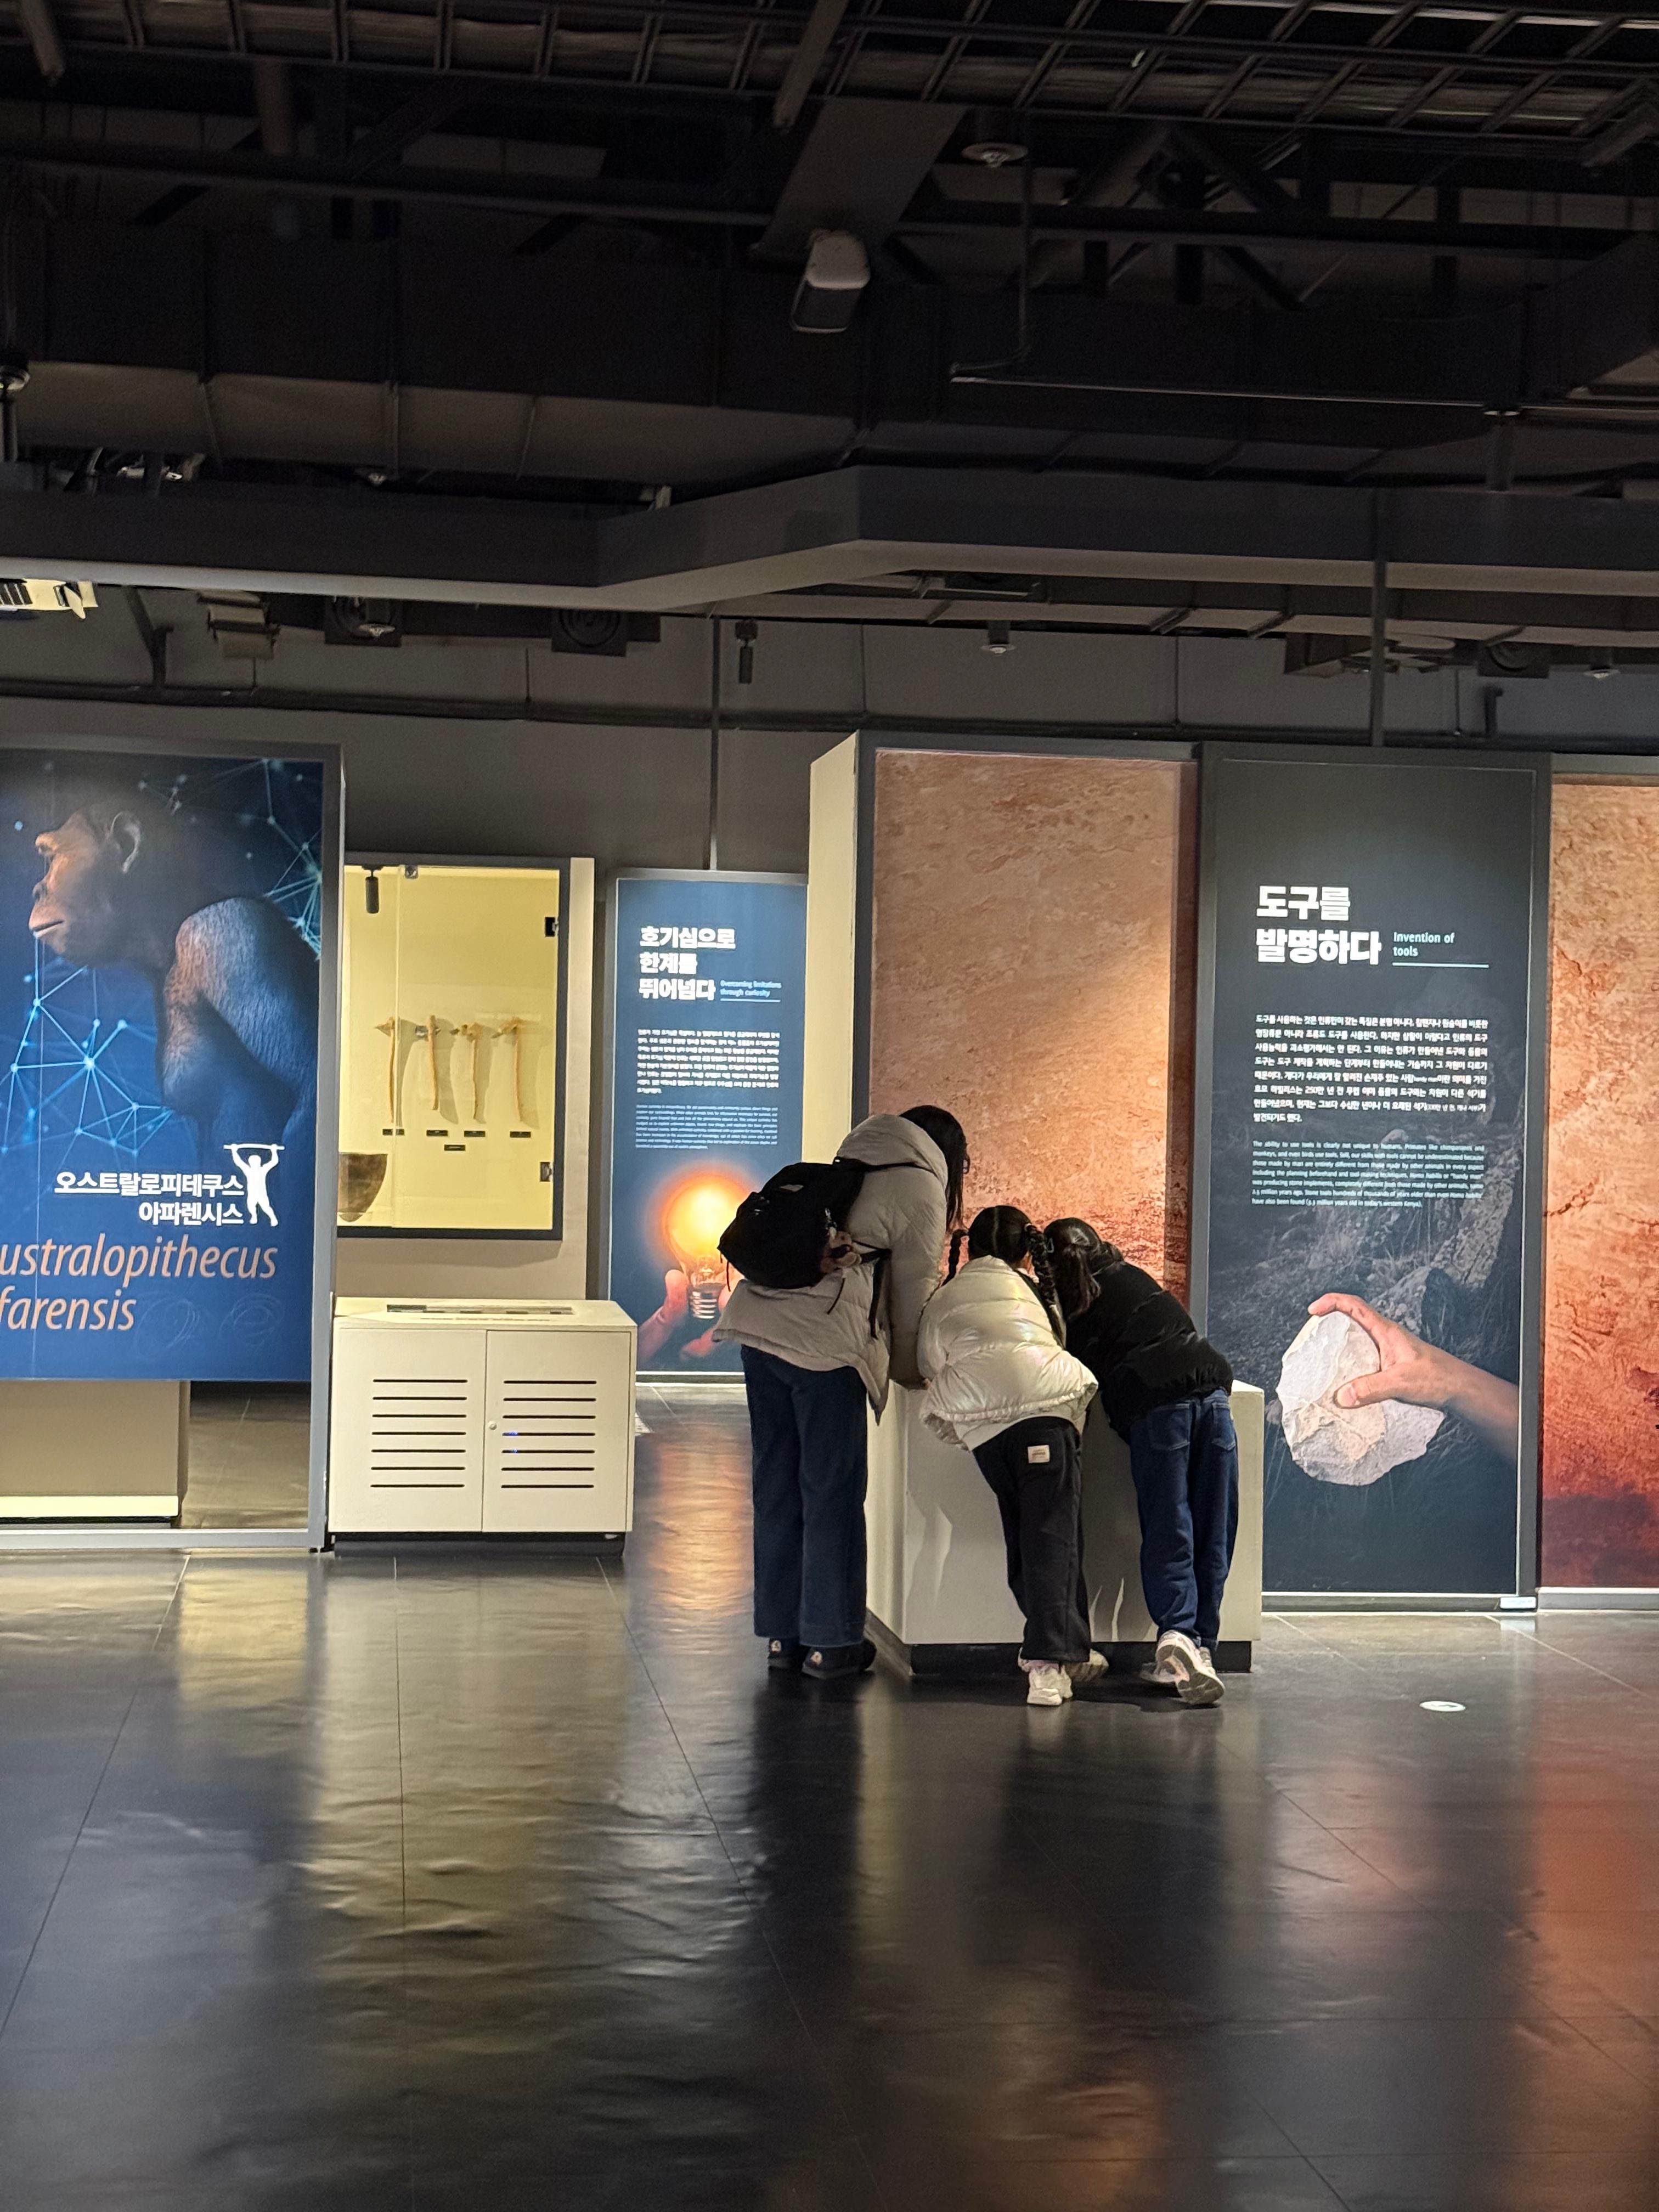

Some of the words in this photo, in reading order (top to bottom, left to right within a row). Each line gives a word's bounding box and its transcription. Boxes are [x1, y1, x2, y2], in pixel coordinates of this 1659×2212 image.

[1256, 885, 1350, 921] 도구를
[640, 926, 736, 949] 호기심으로
[1256, 928, 1382, 965] 발명하다
[1393, 932, 1441, 943] Invention
[1444, 932, 1454, 944] of
[639, 951, 698, 974] 한계를
[1393, 946, 1418, 957] tools
[639, 978, 716, 1000] 뛰어넘다
[1256, 1015, 1276, 1024] 도구를
[1276, 1015, 1303, 1024] 사용하는
[1304, 1016, 1317, 1025] 것은
[1379, 1018, 1393, 1026] 분명
[1393, 1018, 1415, 1026] 아니다.
[1283, 1030, 1304, 1038] 아니라
[1328, 1031, 1348, 1040] 도구를
[1350, 1031, 1379, 1040] 사용한다.
[1380, 1031, 1401, 1041] 하지만
[1474, 1034, 1488, 1042] 도구
[1255, 1057, 1275, 1066] 도구는
[1277, 1058, 1291, 1066] 도구
[1346, 1045, 1362, 1053] 된다.
[1468, 1047, 1488, 1057] 동물의
[1284, 1071, 1305, 1080] 게다가
[1385, 1074, 1400, 1082] 있는
[1327, 1086, 1334, 1095] 년
[1362, 1087, 1376, 1096] 이미
[1378, 1087, 1398, 1097] 동물의
[1451, 1089, 1465, 1098] 다른
[54, 1171, 245, 1198] 오스트랄로피테쿠스
[139, 1202, 244, 1226] 아파렌시스
[0, 1233, 278, 1288] ustralopithecus
[0, 1285, 137, 1331] farensis
